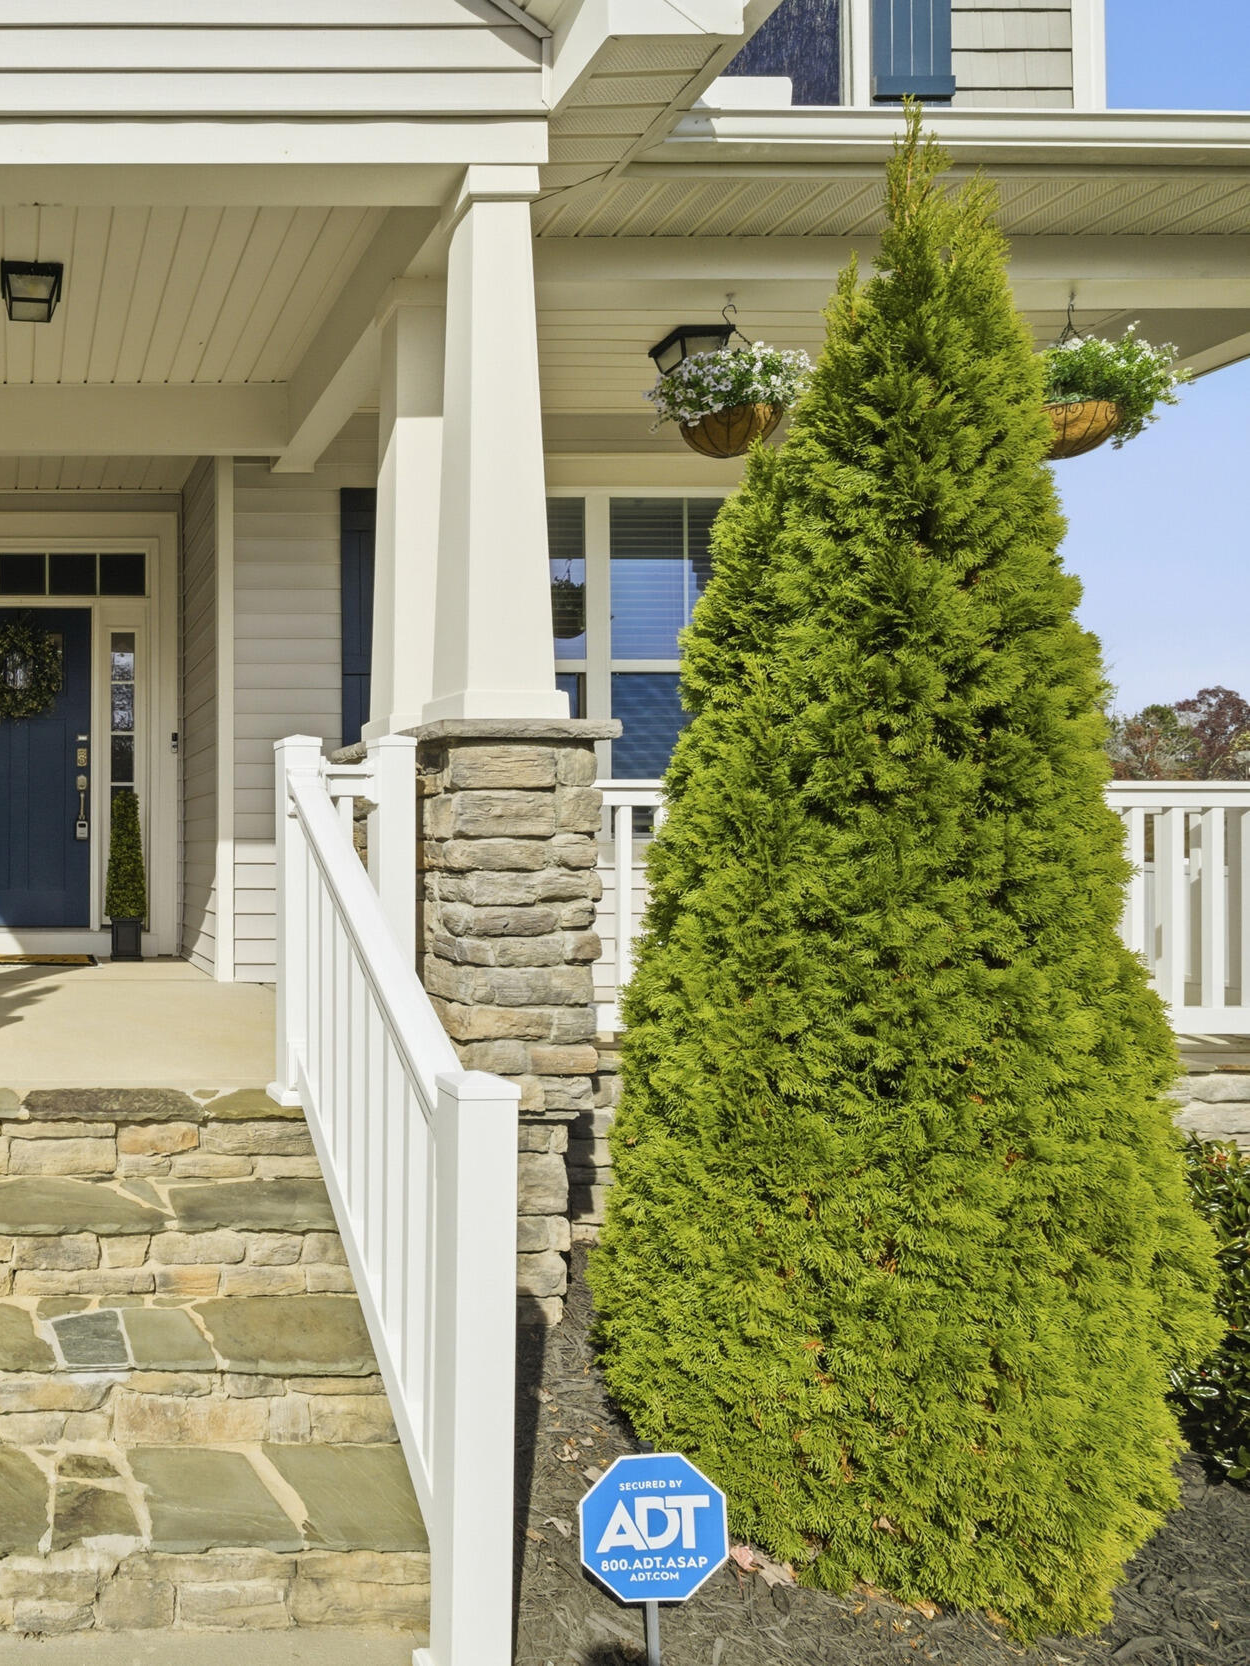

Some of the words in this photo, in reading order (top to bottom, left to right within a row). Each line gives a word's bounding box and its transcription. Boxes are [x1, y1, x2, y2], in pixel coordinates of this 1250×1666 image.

[618, 1480, 666, 1491] SECURED
[669, 1479, 683, 1489] BY
[595, 1494, 710, 1554] ADT
[600, 1556, 708, 1572] 800.ADT.ASAP
[629, 1572, 680, 1582] ADT.COM
